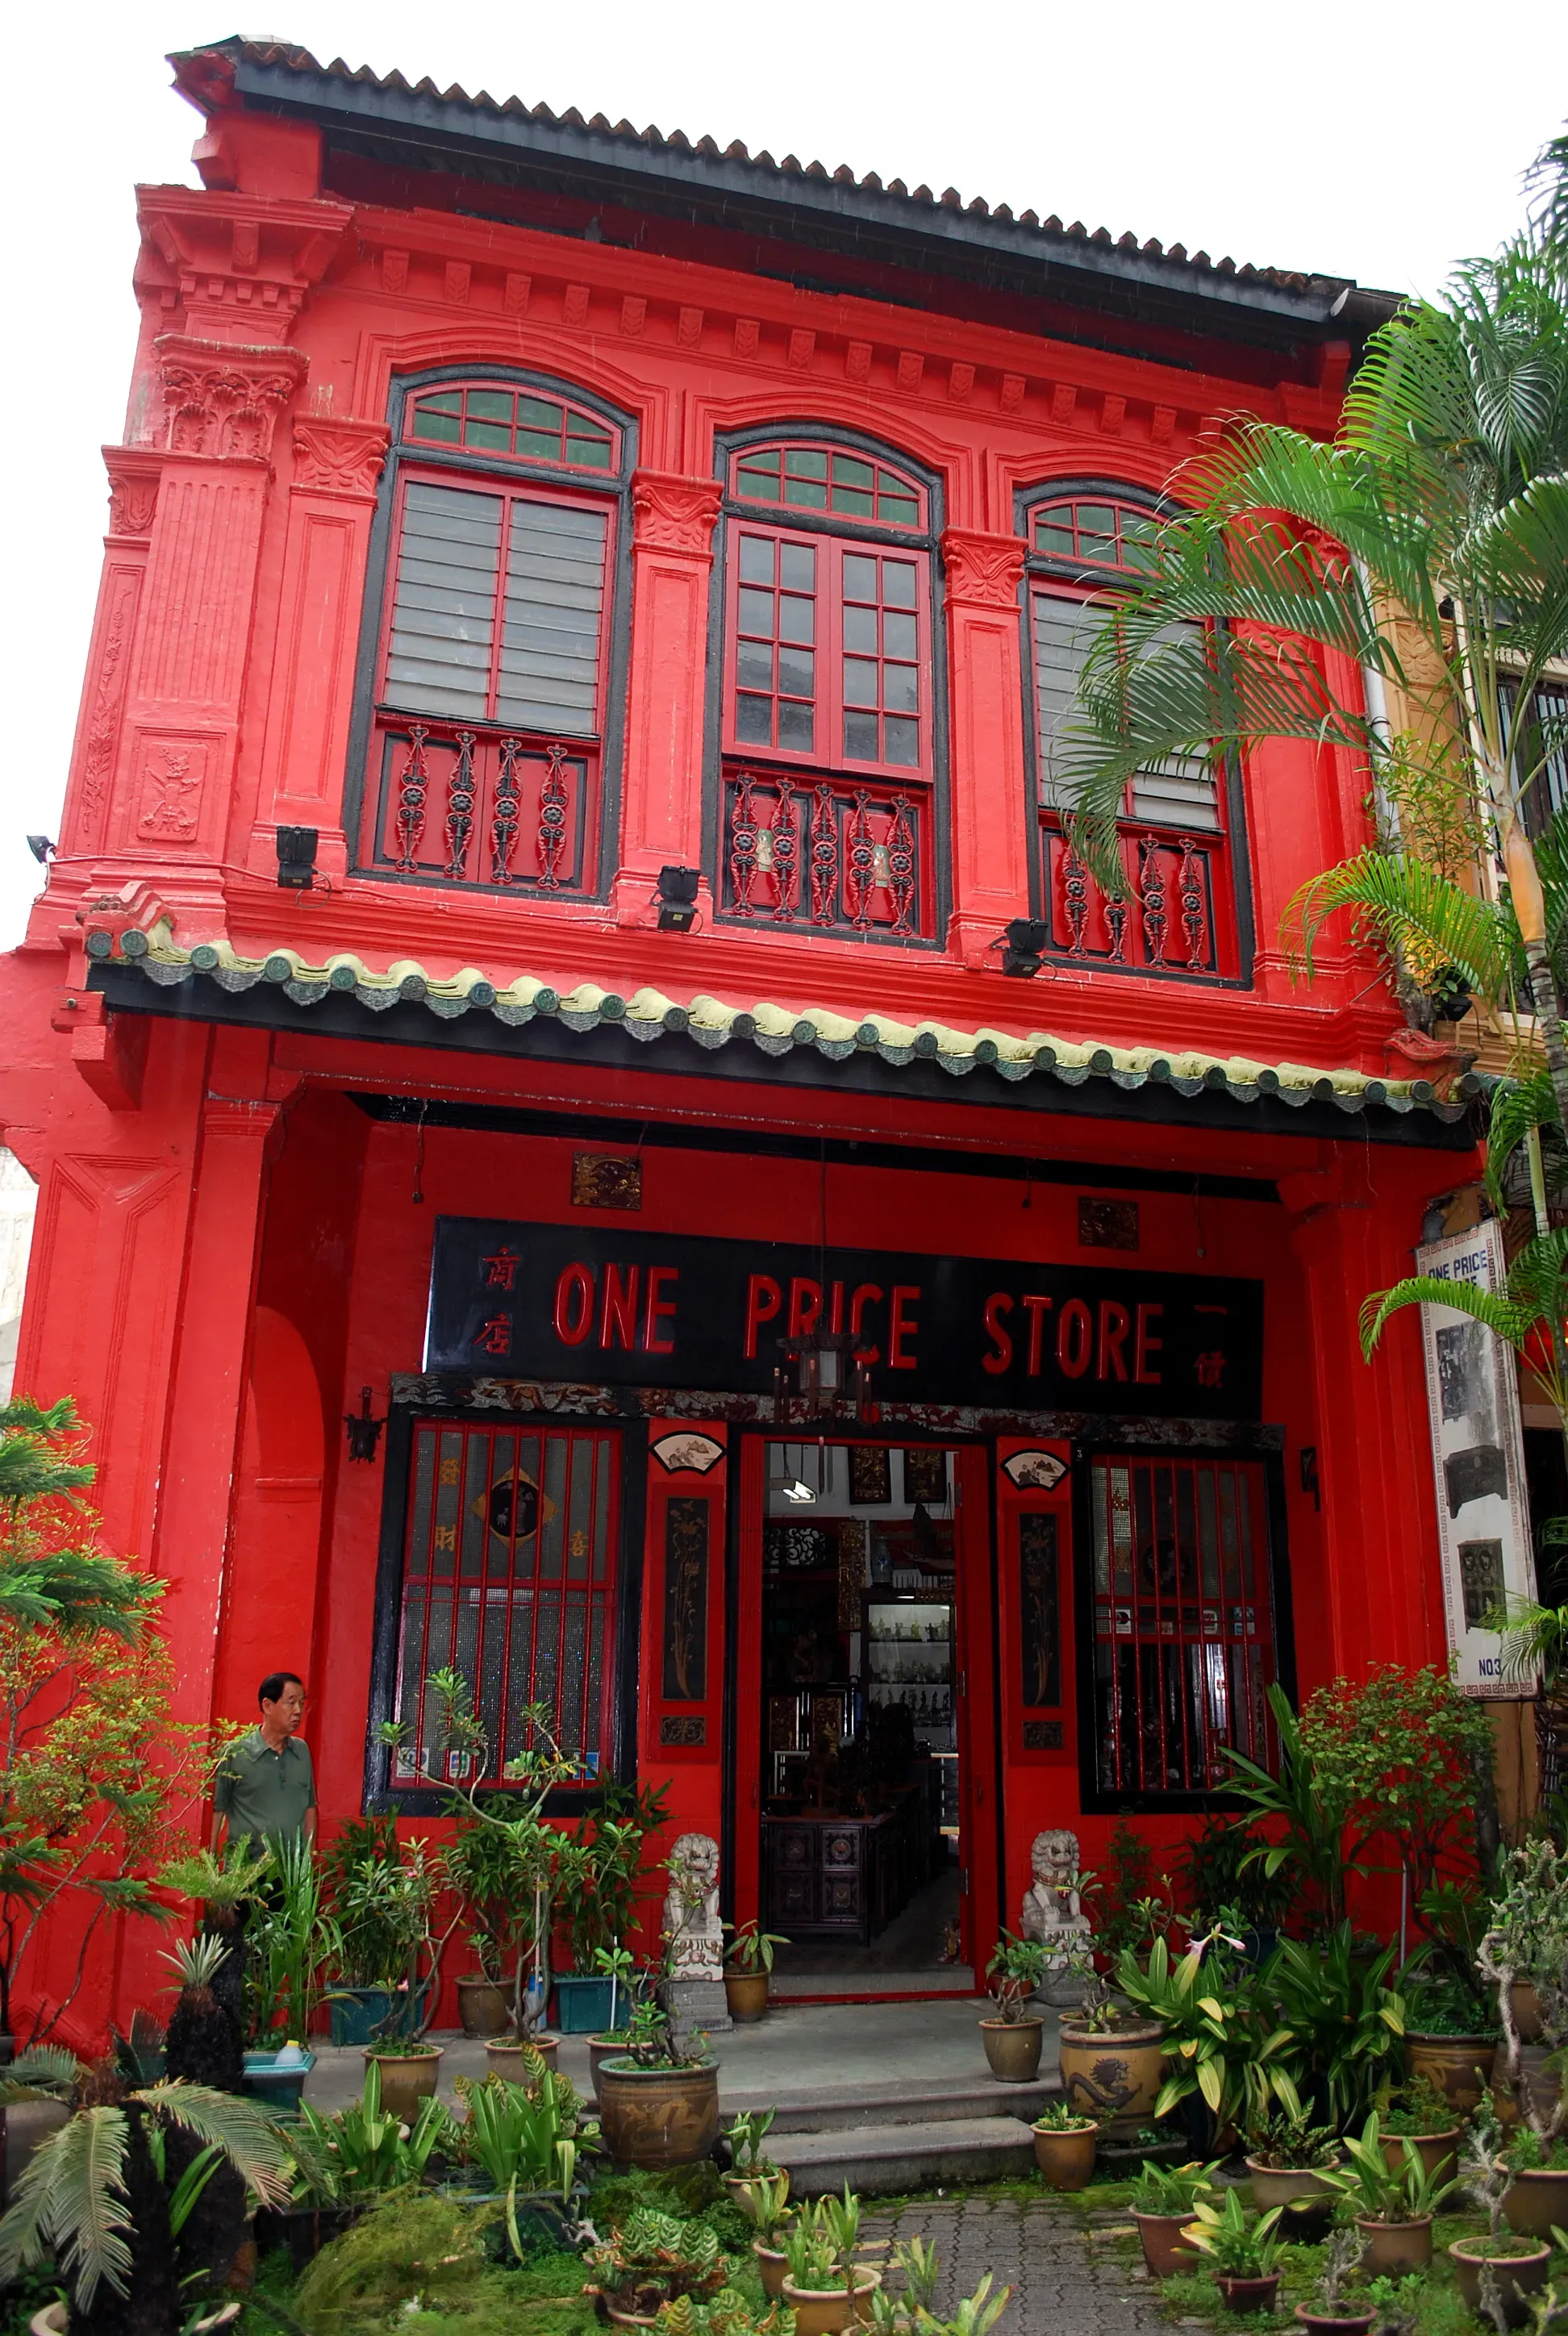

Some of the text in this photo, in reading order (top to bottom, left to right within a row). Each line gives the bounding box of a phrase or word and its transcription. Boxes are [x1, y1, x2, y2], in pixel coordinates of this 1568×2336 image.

[472, 1245, 521, 1354] 商店
[1453, 1249, 1487, 1279] PRICE
[553, 1262, 1165, 1385] ONE PRICE STORE
